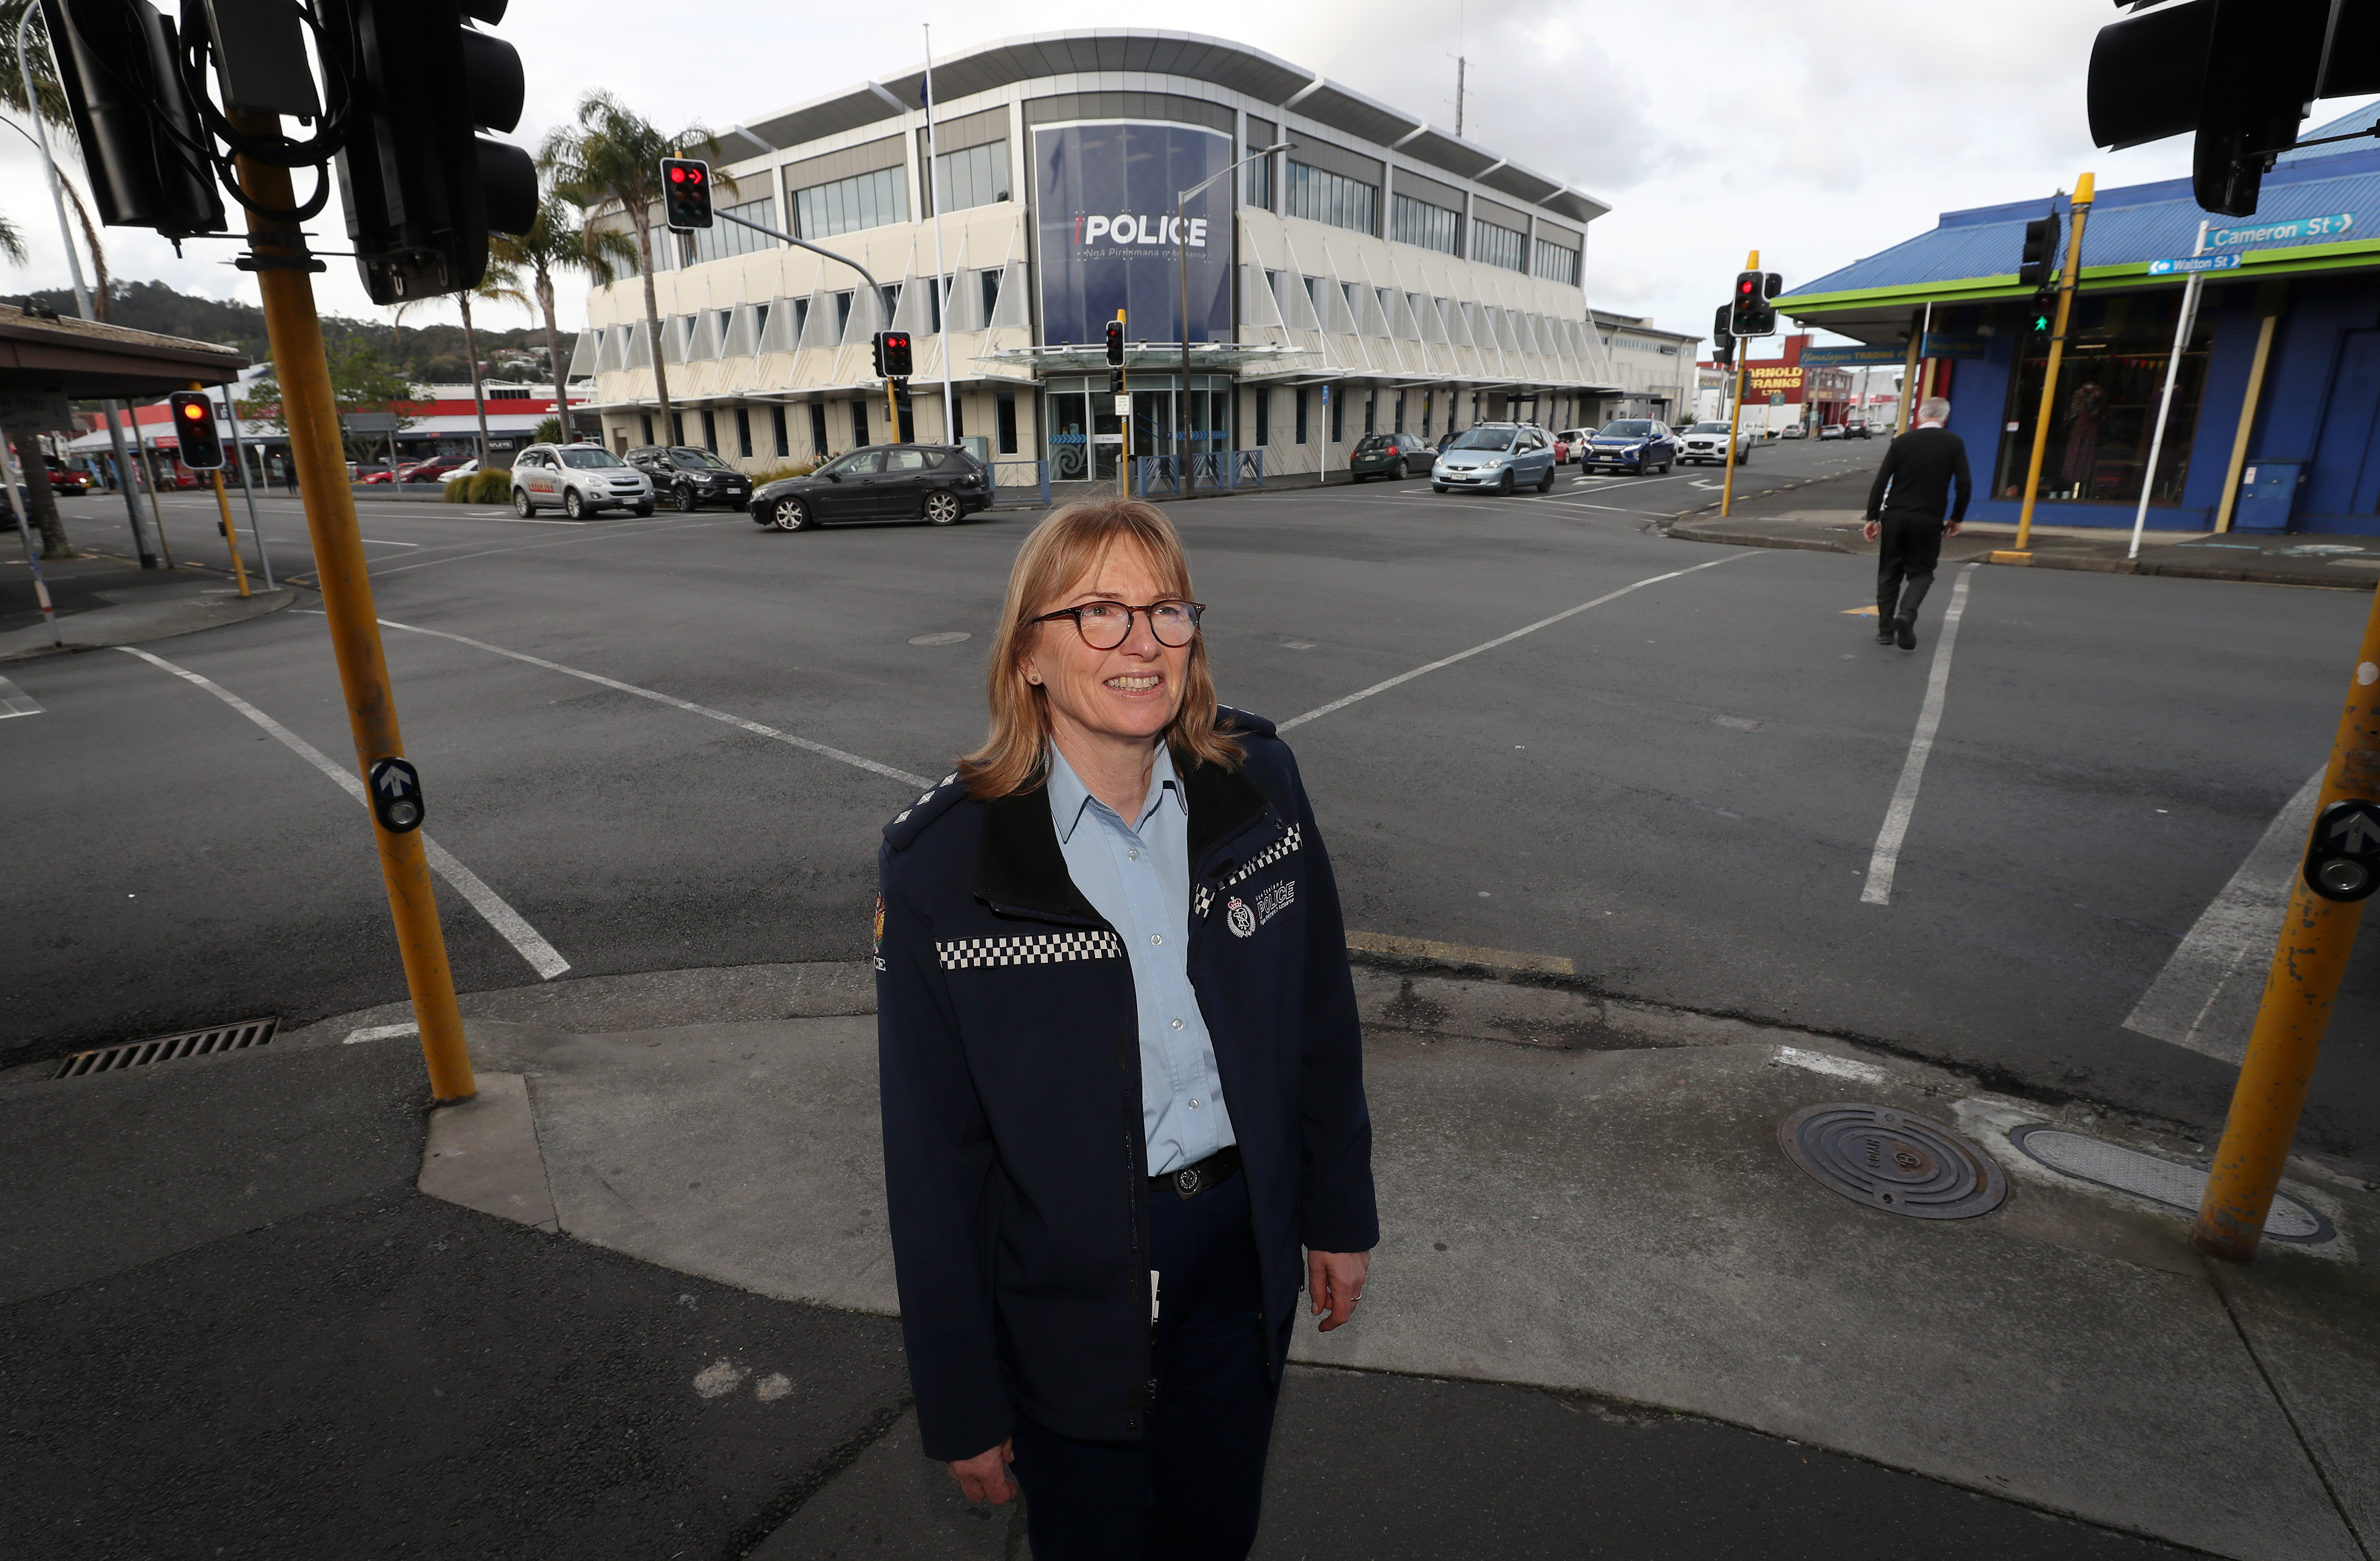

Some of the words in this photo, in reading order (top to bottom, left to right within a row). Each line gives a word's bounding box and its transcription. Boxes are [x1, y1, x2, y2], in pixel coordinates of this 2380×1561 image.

[1085, 215, 1207, 247] POLICE
[2215, 224, 2297, 246] Cameron
[2306, 216, 2331, 236] St
[1172, 249, 1206, 259] Aoearoa
[2173, 258, 2213, 271] Walton
[2214, 255, 2229, 268] St
[1748, 367, 1804, 378] ARNOLD
[1257, 881, 1295, 920] POLICE
